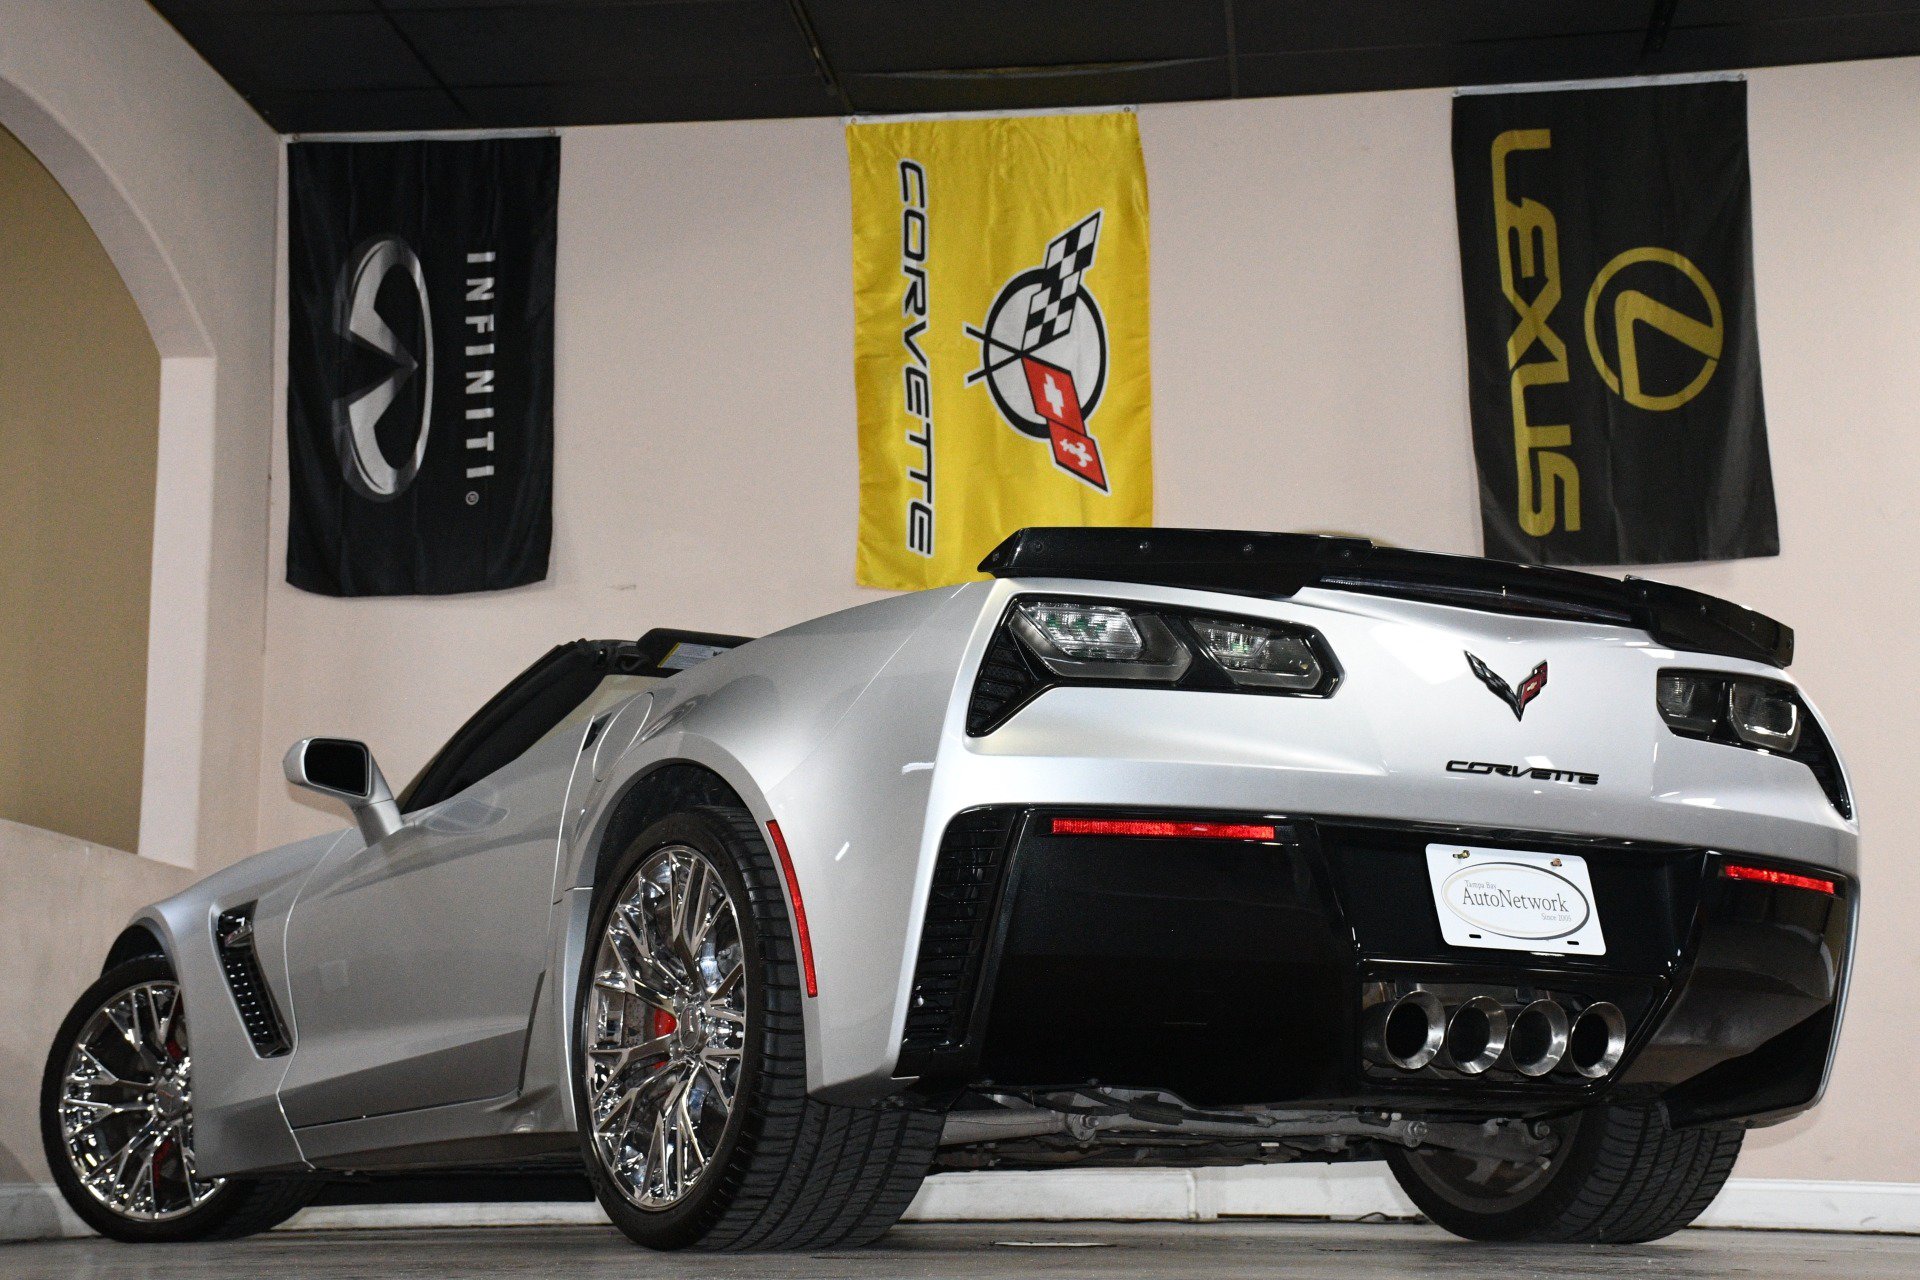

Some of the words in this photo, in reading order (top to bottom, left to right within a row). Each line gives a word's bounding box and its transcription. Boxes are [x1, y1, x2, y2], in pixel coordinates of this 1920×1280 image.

[1491, 128, 1581, 537] LEXUS
[466, 251, 496, 479] INFINITI
[899, 159, 934, 557] CORVETTE
[1446, 760, 1600, 785] CORVETTE
[1464, 880, 1485, 890] Tampa
[1486, 882, 1497, 891] Bay
[1462, 887, 1570, 912] AutoNetwork
[1541, 912, 1557, 921] Since
